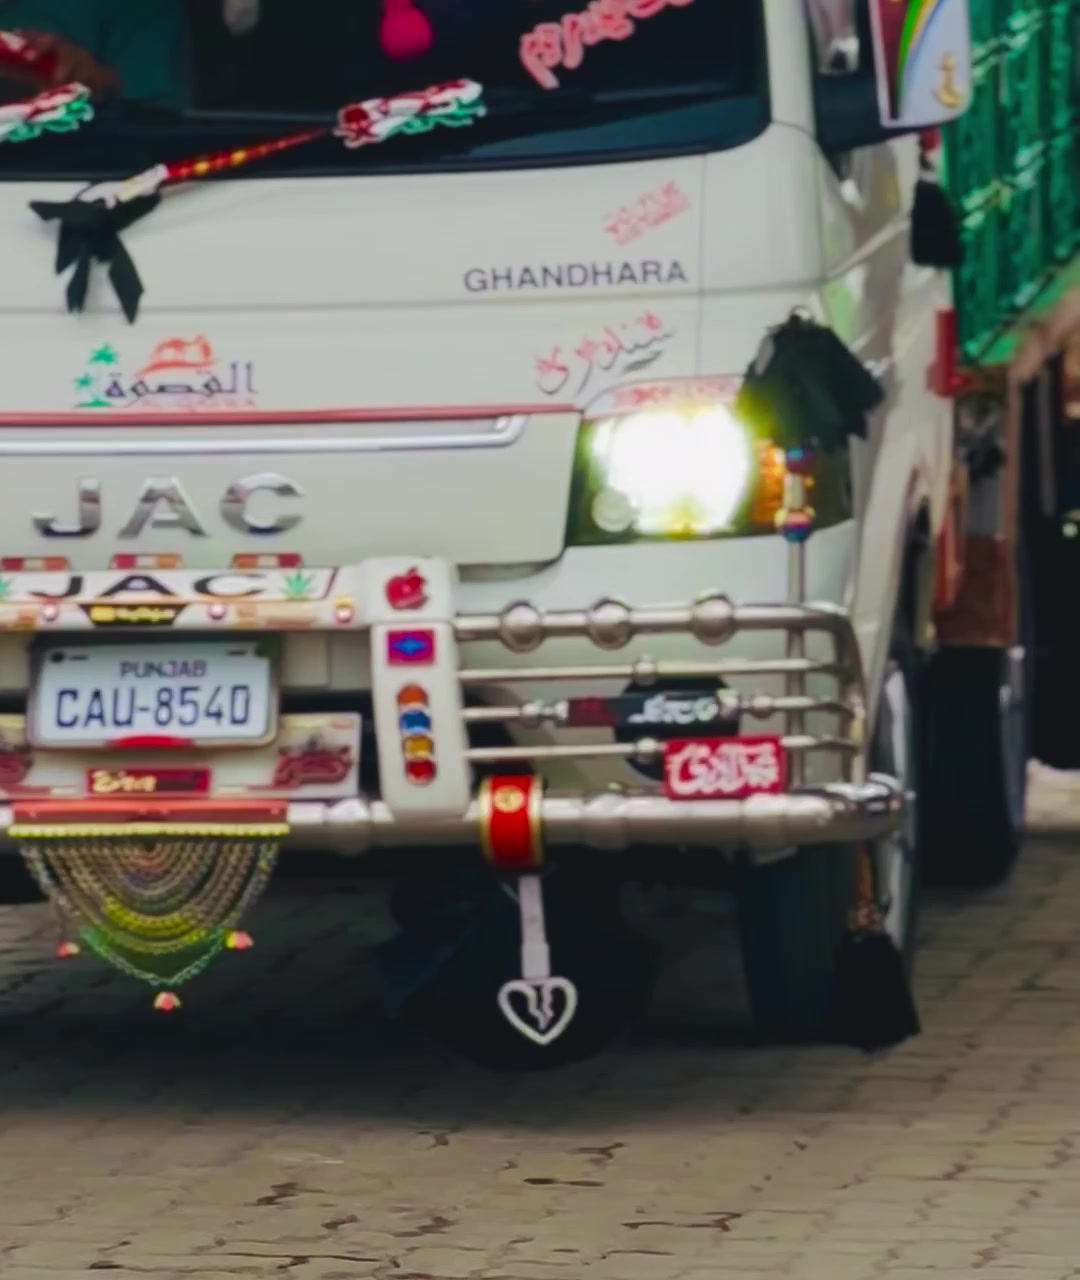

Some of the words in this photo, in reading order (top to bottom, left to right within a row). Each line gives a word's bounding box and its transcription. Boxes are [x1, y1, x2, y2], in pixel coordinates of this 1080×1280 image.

[464, 260, 688, 292] GHANDHARA
[31, 473, 306, 540] JAC
[29, 574, 268, 598] JAC
[120, 660, 207, 679] PUNJAB
[55, 684, 251, 729] CAU-8540
